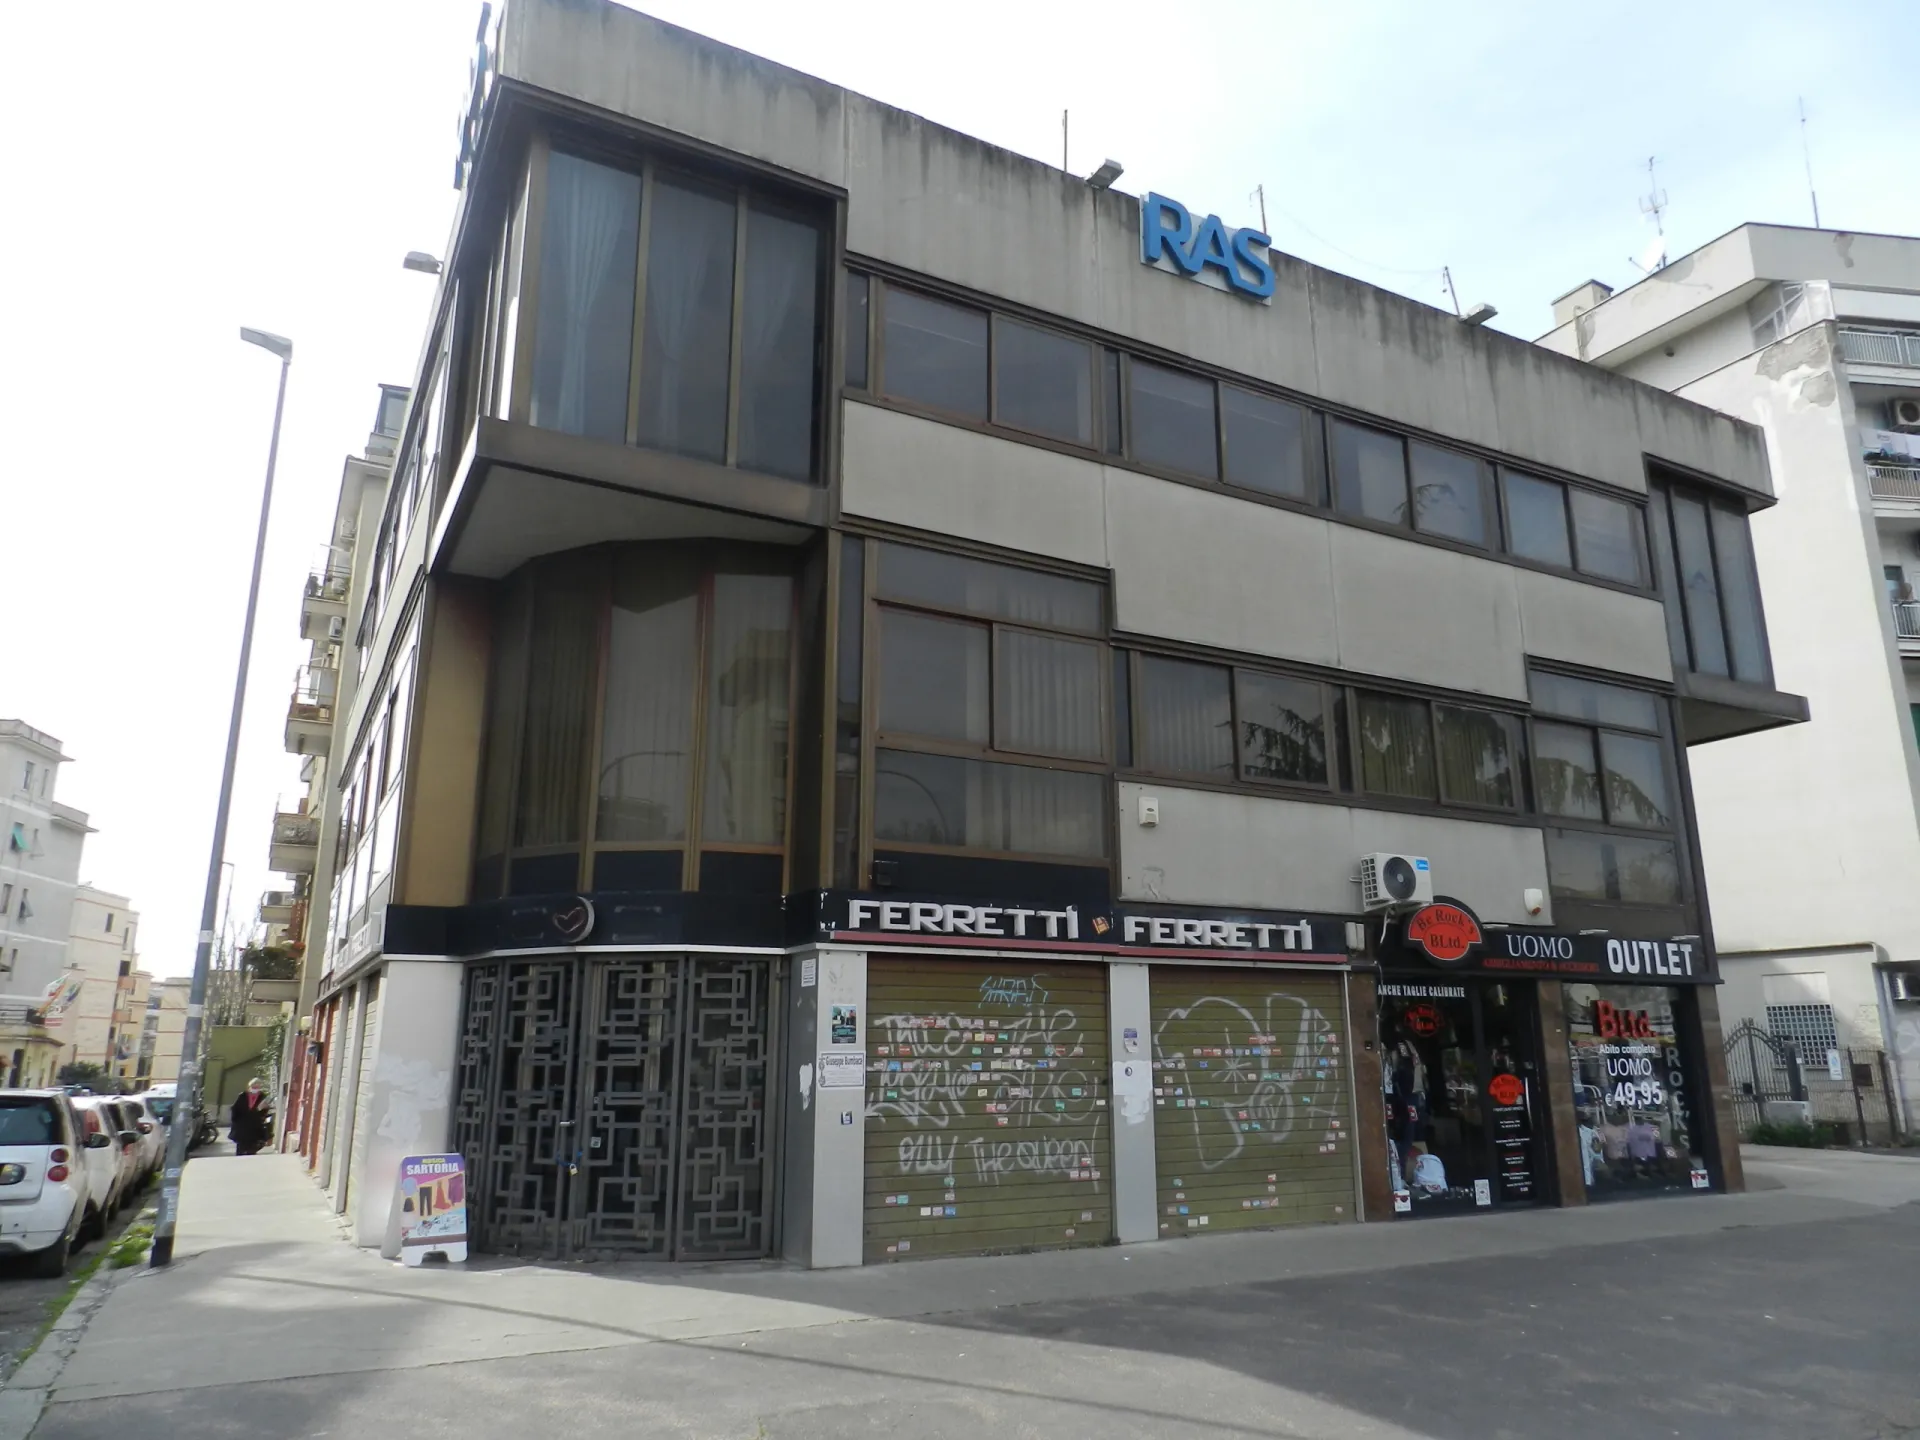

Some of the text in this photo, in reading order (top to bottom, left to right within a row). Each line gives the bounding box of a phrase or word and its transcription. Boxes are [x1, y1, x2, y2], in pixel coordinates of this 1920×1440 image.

[1143, 191, 1276, 297] RAS
[848, 899, 1079, 940] FERRETTI
[1124, 916, 1313, 950] FERRETTI
[1506, 934, 1573, 959] UOMO
[1606, 938, 1693, 976] OUTLET
[1377, 985, 1465, 997] ANCHE TAGLIE CALIBRATE
[1600, 1044, 1656, 1056] Abito completo
[1607, 1058, 1652, 1076] UOMO
[406, 1162, 460, 1175] SARTORIA
